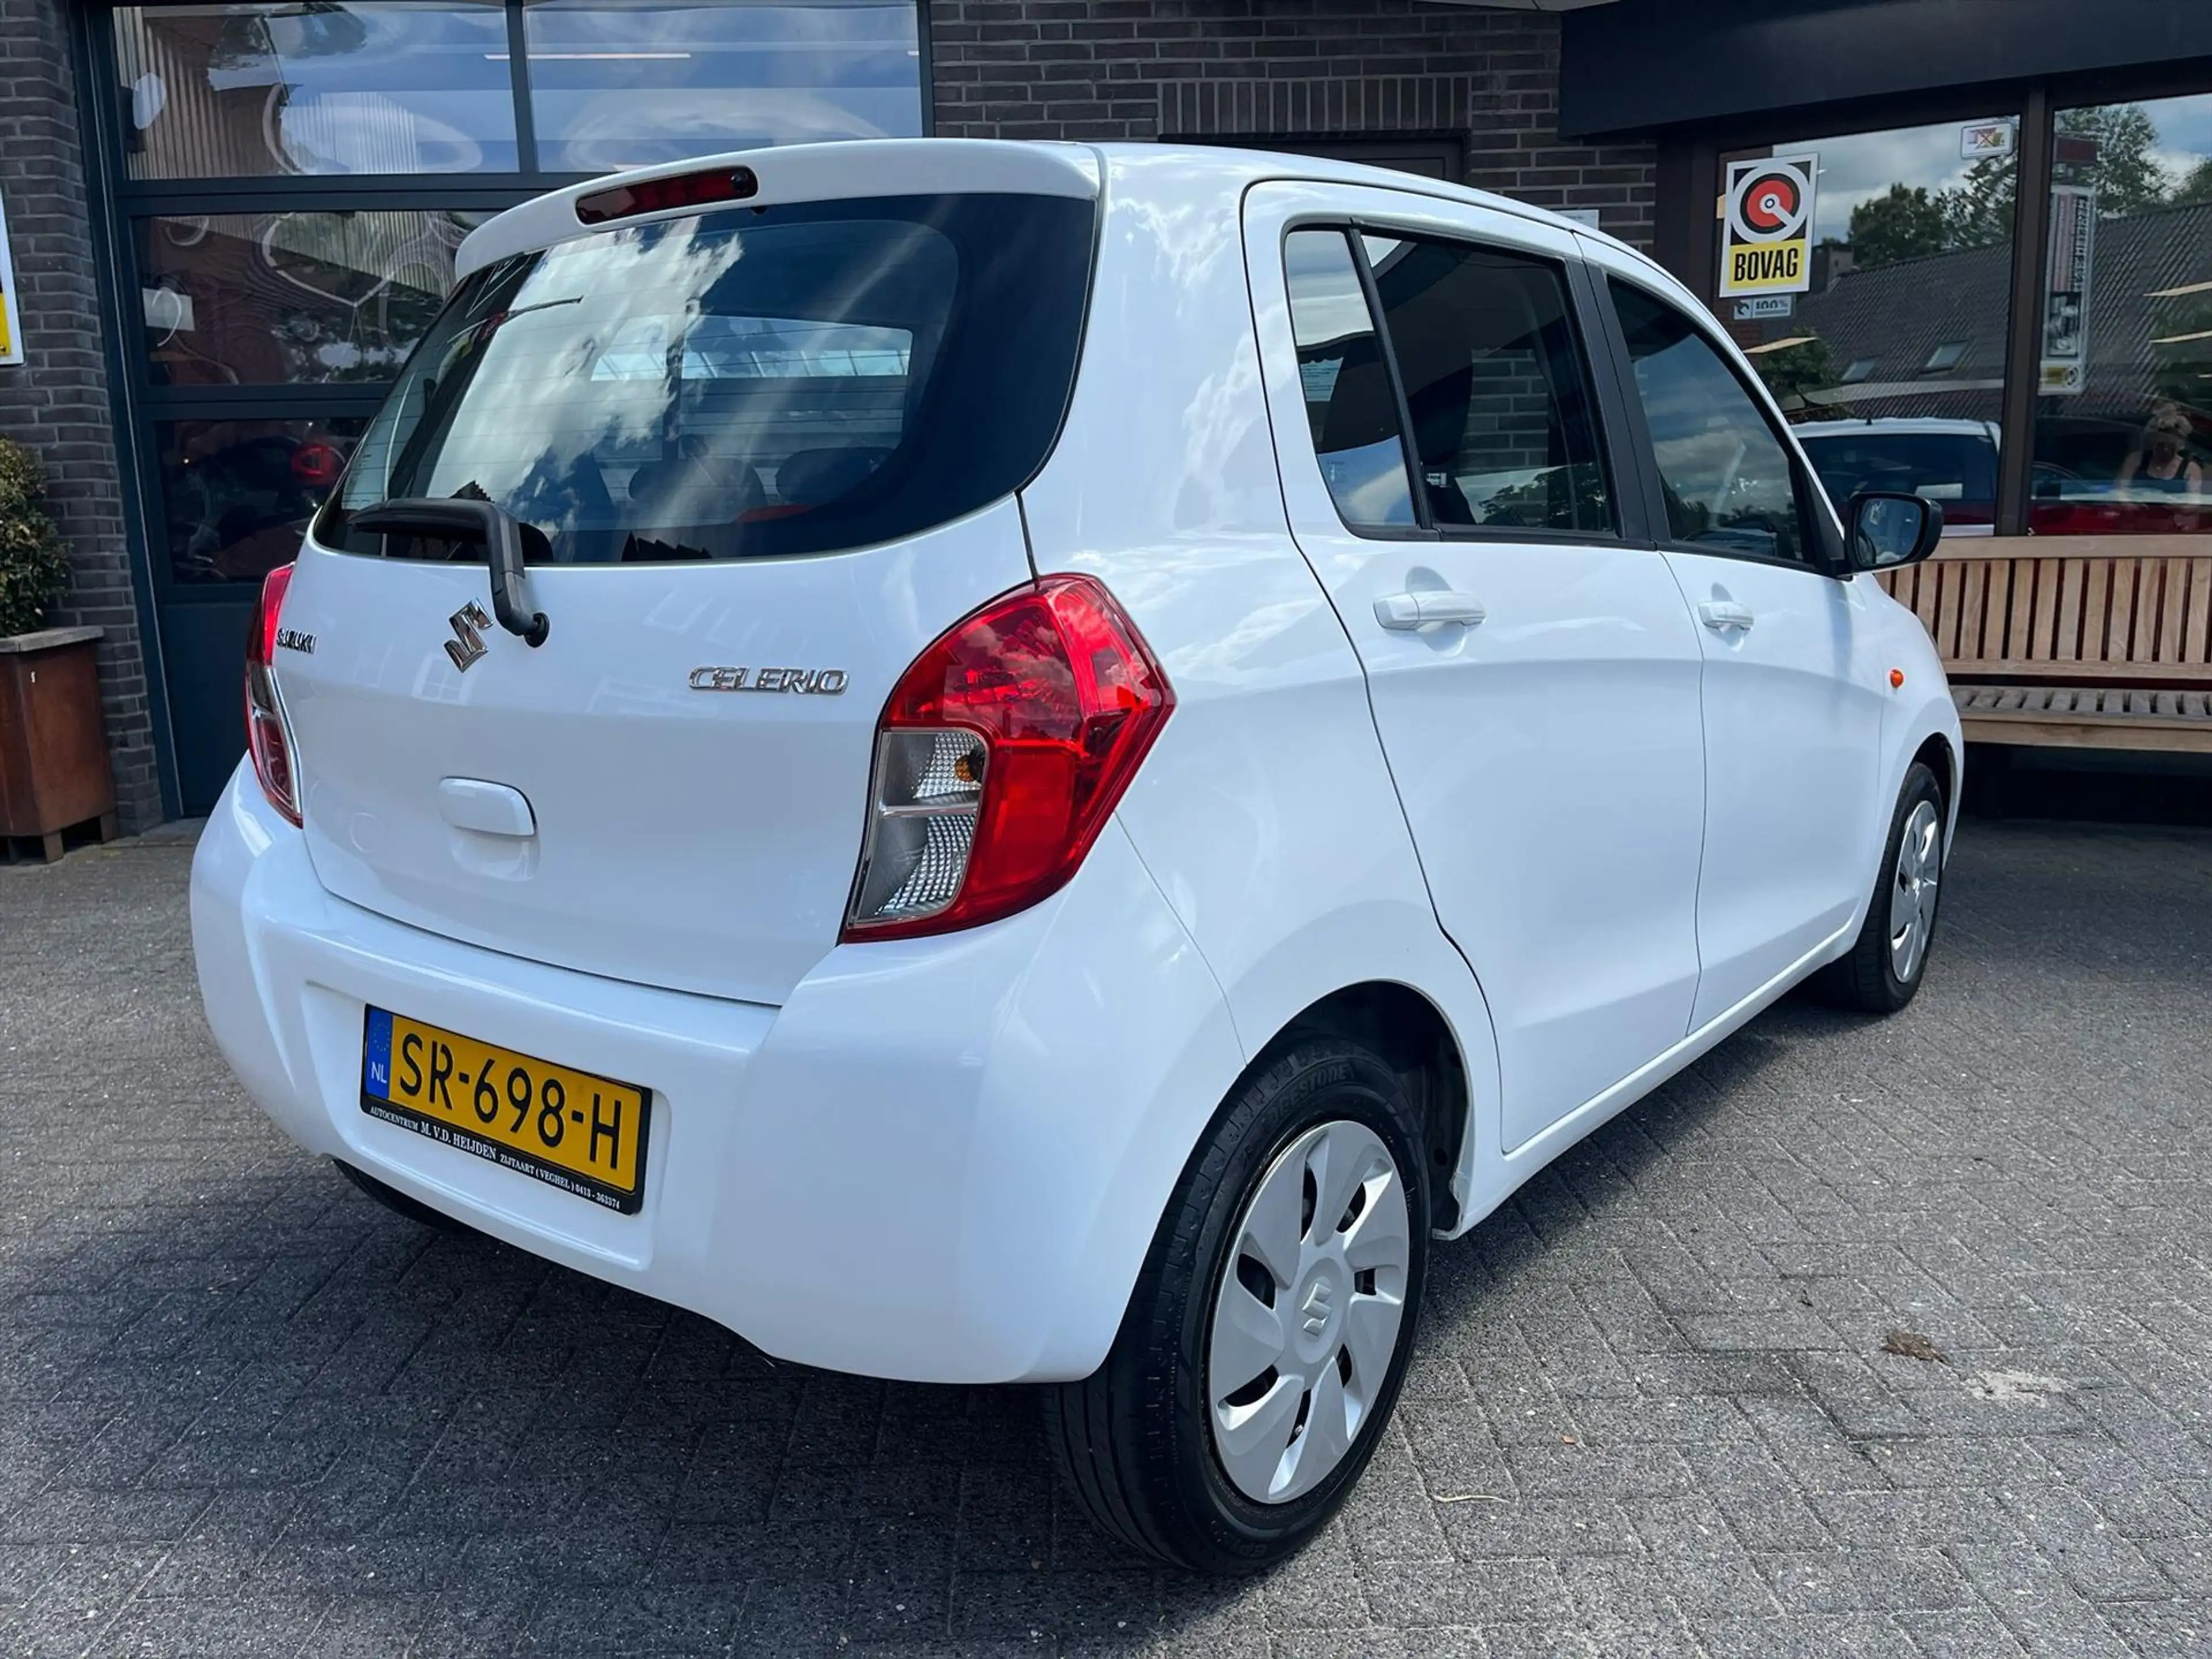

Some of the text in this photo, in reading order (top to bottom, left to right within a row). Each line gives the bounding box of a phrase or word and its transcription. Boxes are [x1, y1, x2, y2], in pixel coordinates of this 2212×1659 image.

[1734, 247, 1798, 282] BOVAG
[277, 627, 317, 655] SUZUKI
[689, 666, 850, 695] CELERIO
[371, 1062, 387, 1084] NL
[400, 1033, 622, 1171] SR-698-H
[370, 1105, 418, 1131] AUTOCENTRUM
[421, 1121, 431, 1137] M.
[433, 1125, 452, 1144] V.D.
[453, 1132, 497, 1160] HEIJDEN
[499, 1153, 535, 1175] ZIJTAART
